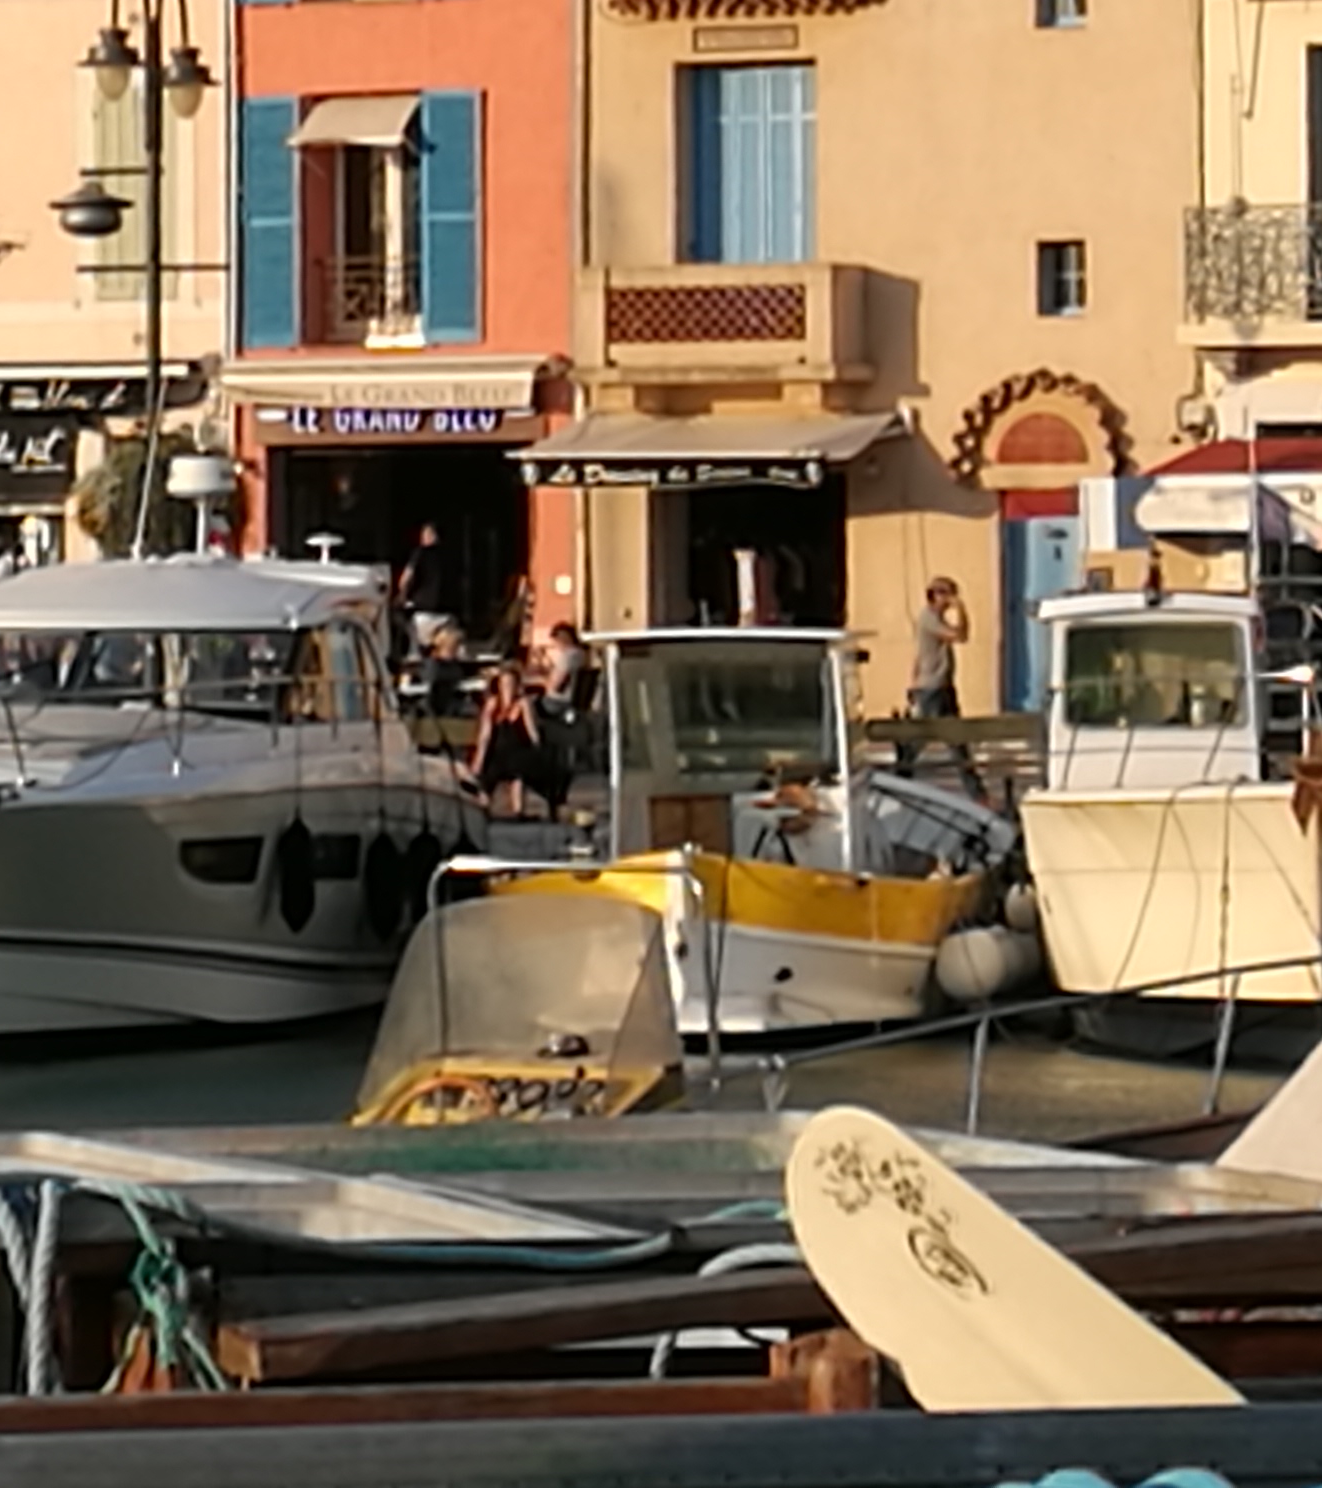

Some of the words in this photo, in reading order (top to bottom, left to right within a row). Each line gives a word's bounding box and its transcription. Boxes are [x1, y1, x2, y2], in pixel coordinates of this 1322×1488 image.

[290, 408, 321, 433] LE
[333, 408, 420, 433] GRAND
[432, 407, 496, 432] BLEU
